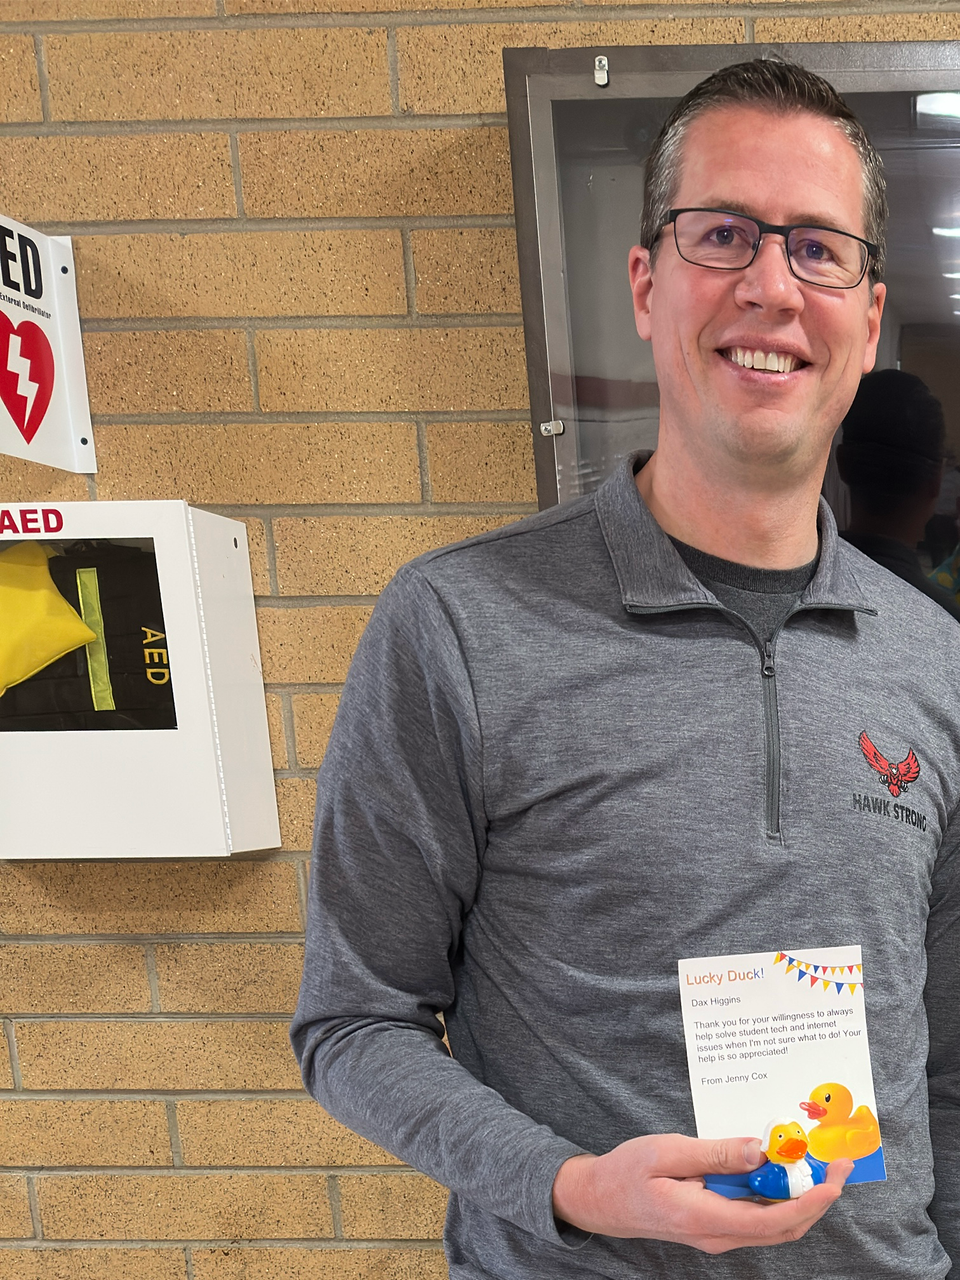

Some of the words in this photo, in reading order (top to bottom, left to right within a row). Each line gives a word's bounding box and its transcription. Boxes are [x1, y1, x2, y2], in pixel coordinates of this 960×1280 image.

[0, 508, 64, 534] AED
[141, 626, 170, 686] AED
[852, 793, 891, 817] HAWK
[686, 972, 723, 986] Lucky
[727, 967, 765, 982] Duck!
[691, 999, 709, 1008] Dax
[710, 996, 741, 1006] Higgins
[694, 1019, 720, 1029] Thank
[721, 1019, 737, 1029] you
[739, 1017, 750, 1025] for
[751, 1016, 770, 1026] your
[771, 1011, 815, 1022] willingness
[817, 1010, 825, 1018] to
[826, 1008, 854, 1017] always
[695, 1032, 713, 1041] help
[715, 1030, 737, 1039] solve
[738, 1027, 769, 1037] student
[770, 1025, 788, 1033] tech
[789, 1023, 805, 1032] and
[806, 1020, 837, 1029] internet
[696, 1044, 723, 1052] issues
[725, 1041, 747, 1049] when
[749, 1039, 761, 1047] I'm
[763, 1037, 776, 1046] not
[778, 1036, 796, 1044] sure
[797, 1033, 817, 1042] what
[818, 1032, 827, 1040] to
[828, 1030, 841, 1039] do!
[842, 1029, 861, 1037] Your
[698, 1054, 716, 1063] help
[717, 1053, 725, 1061] is
[739, 1047, 788, 1060] appreciated!
[701, 1077, 723, 1085] From
[725, 1074, 750, 1083] Jenny
[751, 1072, 768, 1080] Cox
